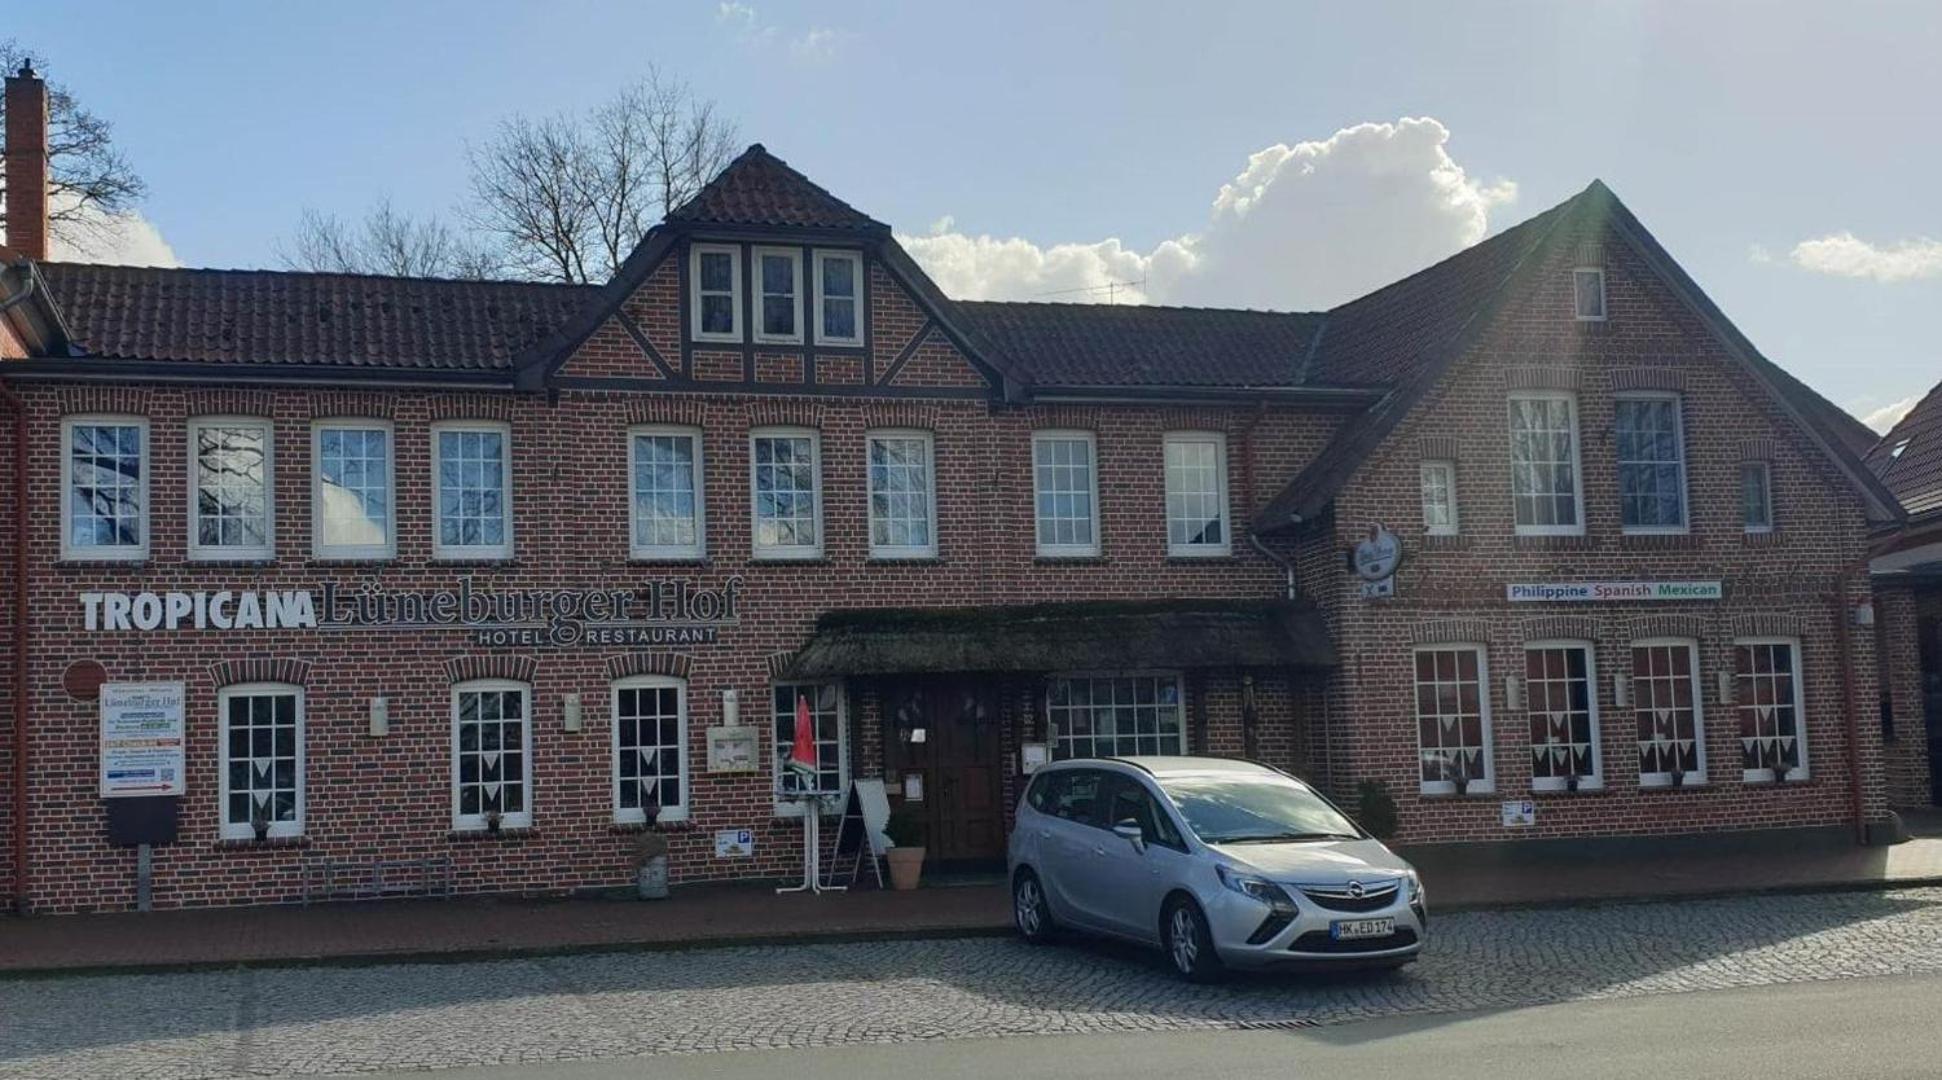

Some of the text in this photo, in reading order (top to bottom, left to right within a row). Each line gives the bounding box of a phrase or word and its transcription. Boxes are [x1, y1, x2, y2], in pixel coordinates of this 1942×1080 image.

[1512, 583, 1718, 599] Philippine Spanish Mexican
[79, 574, 744, 646] TROPICANA Lüneburger Hof
[478, 627, 717, 645] HOTEL RESTAURANT
